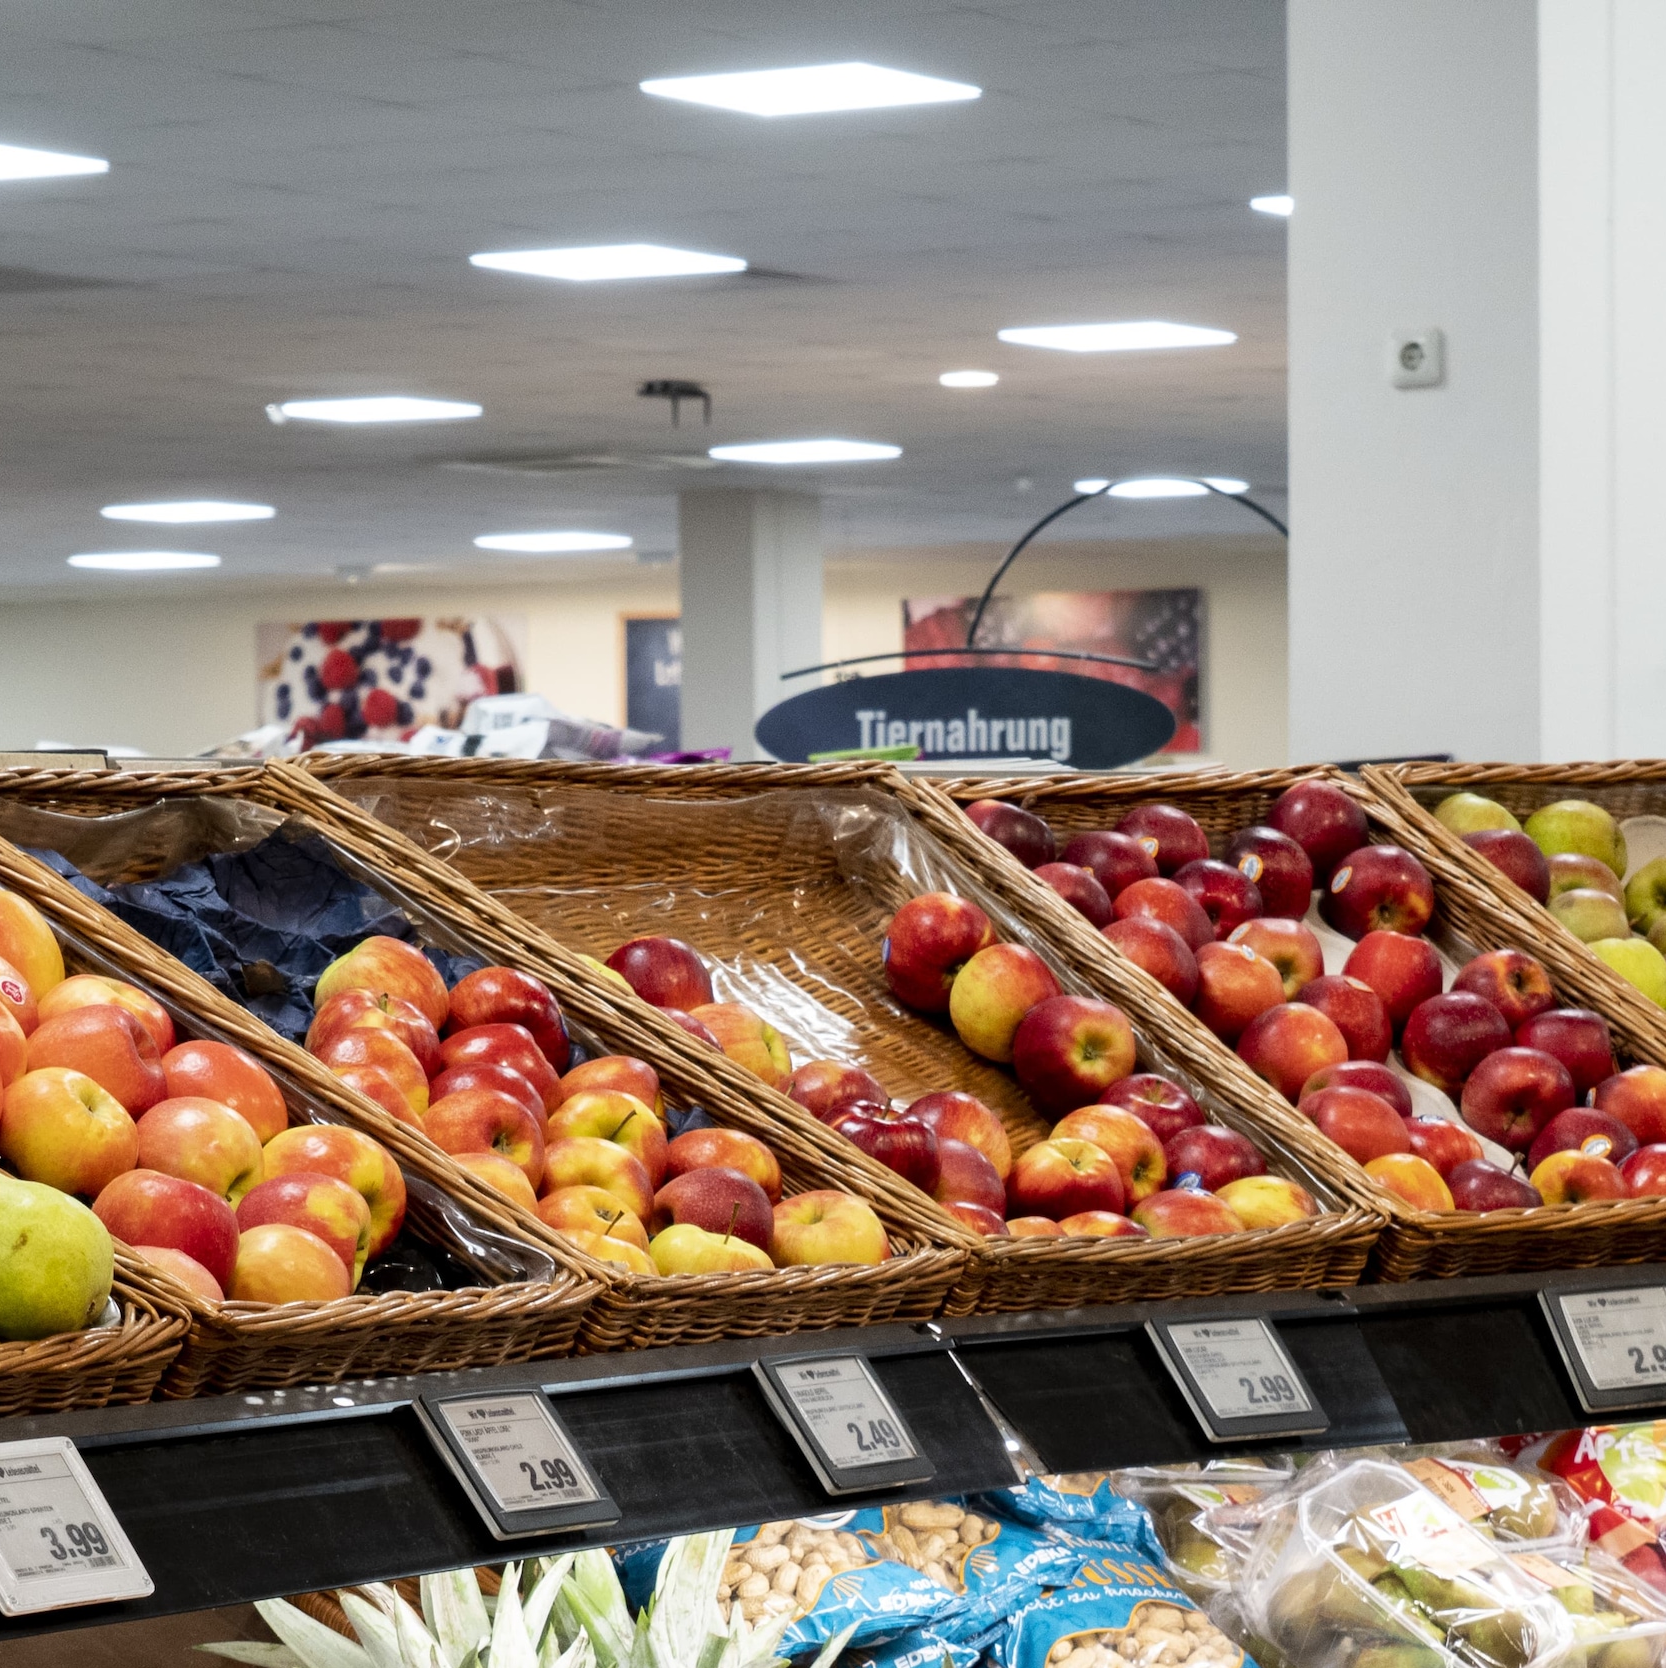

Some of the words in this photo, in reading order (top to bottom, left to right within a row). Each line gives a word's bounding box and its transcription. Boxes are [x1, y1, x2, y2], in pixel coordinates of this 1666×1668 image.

[855, 708, 1071, 759] Tiernahrung
[1238, 1374, 1296, 1404] 2.99
[846, 1418, 901, 1452] 2.49
[519, 1457, 579, 1492] 2.99
[39, 1521, 110, 1561] 3.99
[1014, 1545, 1072, 1576] EDEKA
